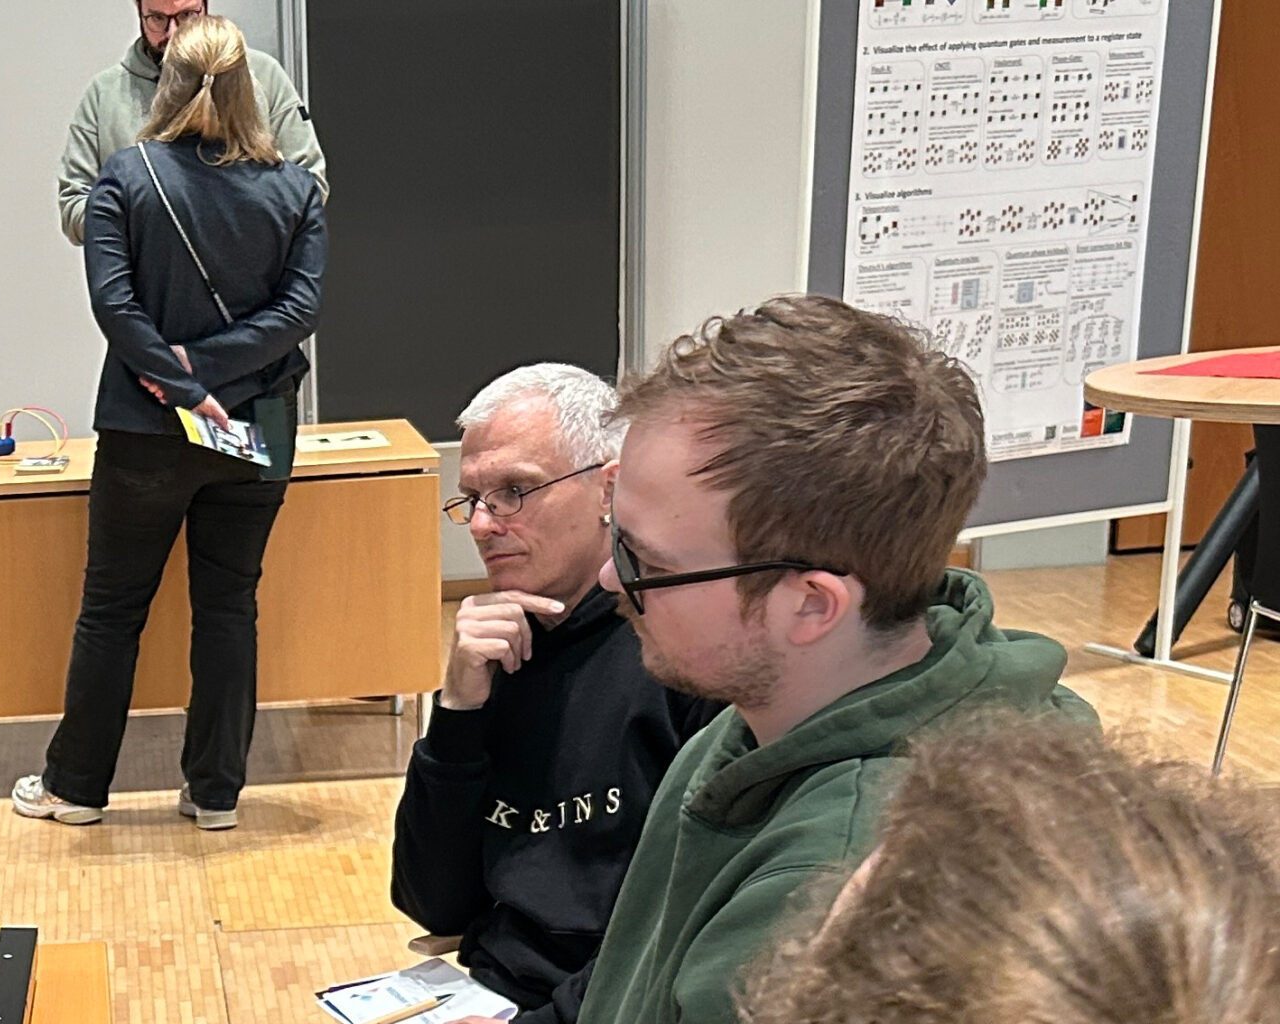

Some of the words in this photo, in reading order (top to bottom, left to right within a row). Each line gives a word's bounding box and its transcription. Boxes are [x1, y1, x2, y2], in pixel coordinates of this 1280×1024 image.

[872, 45, 904, 54] Visualize
[905, 43, 917, 53] the
[918, 42, 938, 52] effect
[939, 41, 947, 51] of
[948, 41, 976, 52] applying
[978, 40, 1008, 50] quantum
[1009, 38, 1026, 49] gates
[1028, 36, 1041, 46] and
[1041, 34, 1086, 45] measurement
[1100, 32, 1126, 44] register
[1126, 31, 1143, 40] state
[864, 189, 895, 200] Visualize
[896, 187, 933, 199] algorithms
